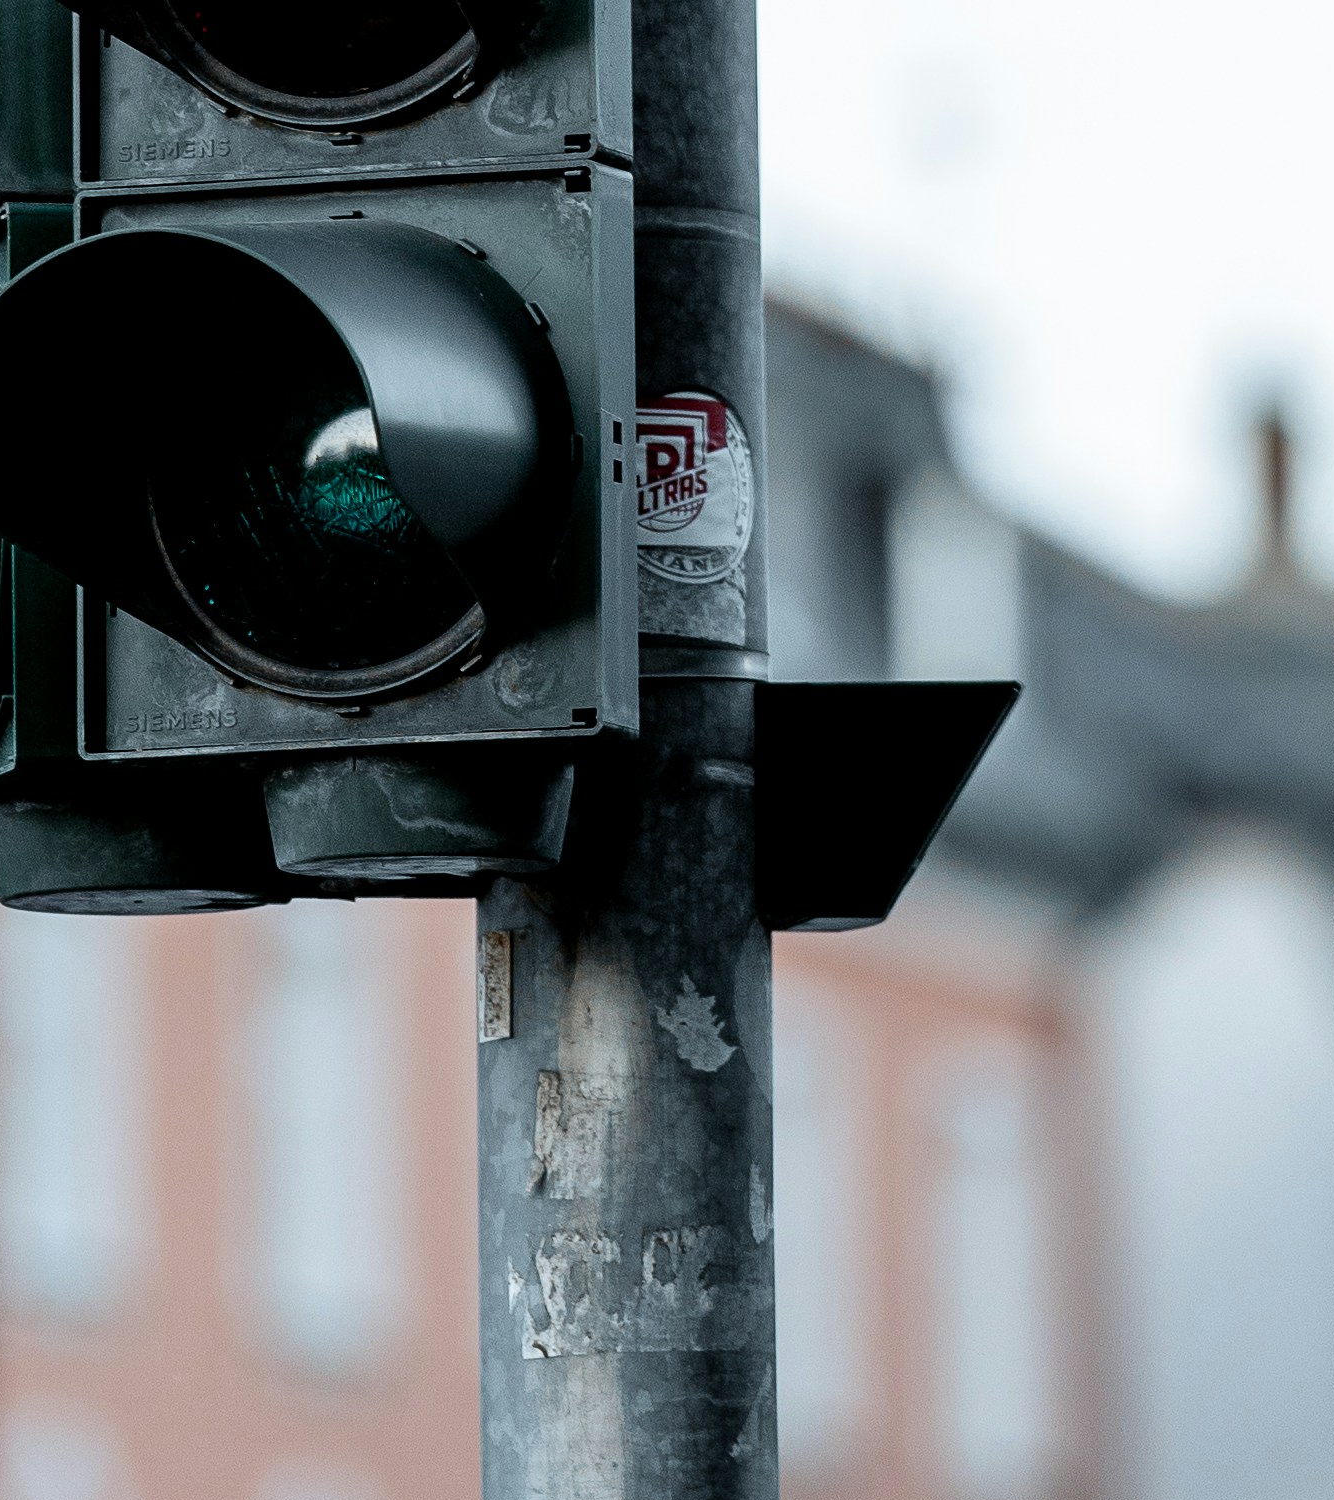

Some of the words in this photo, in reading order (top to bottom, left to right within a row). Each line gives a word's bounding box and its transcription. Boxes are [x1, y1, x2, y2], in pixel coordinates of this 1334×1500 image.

[118, 139, 233, 163] SIEMENS
[638, 469, 708, 516] LTRAS
[126, 709, 239, 733] SIEMENS
